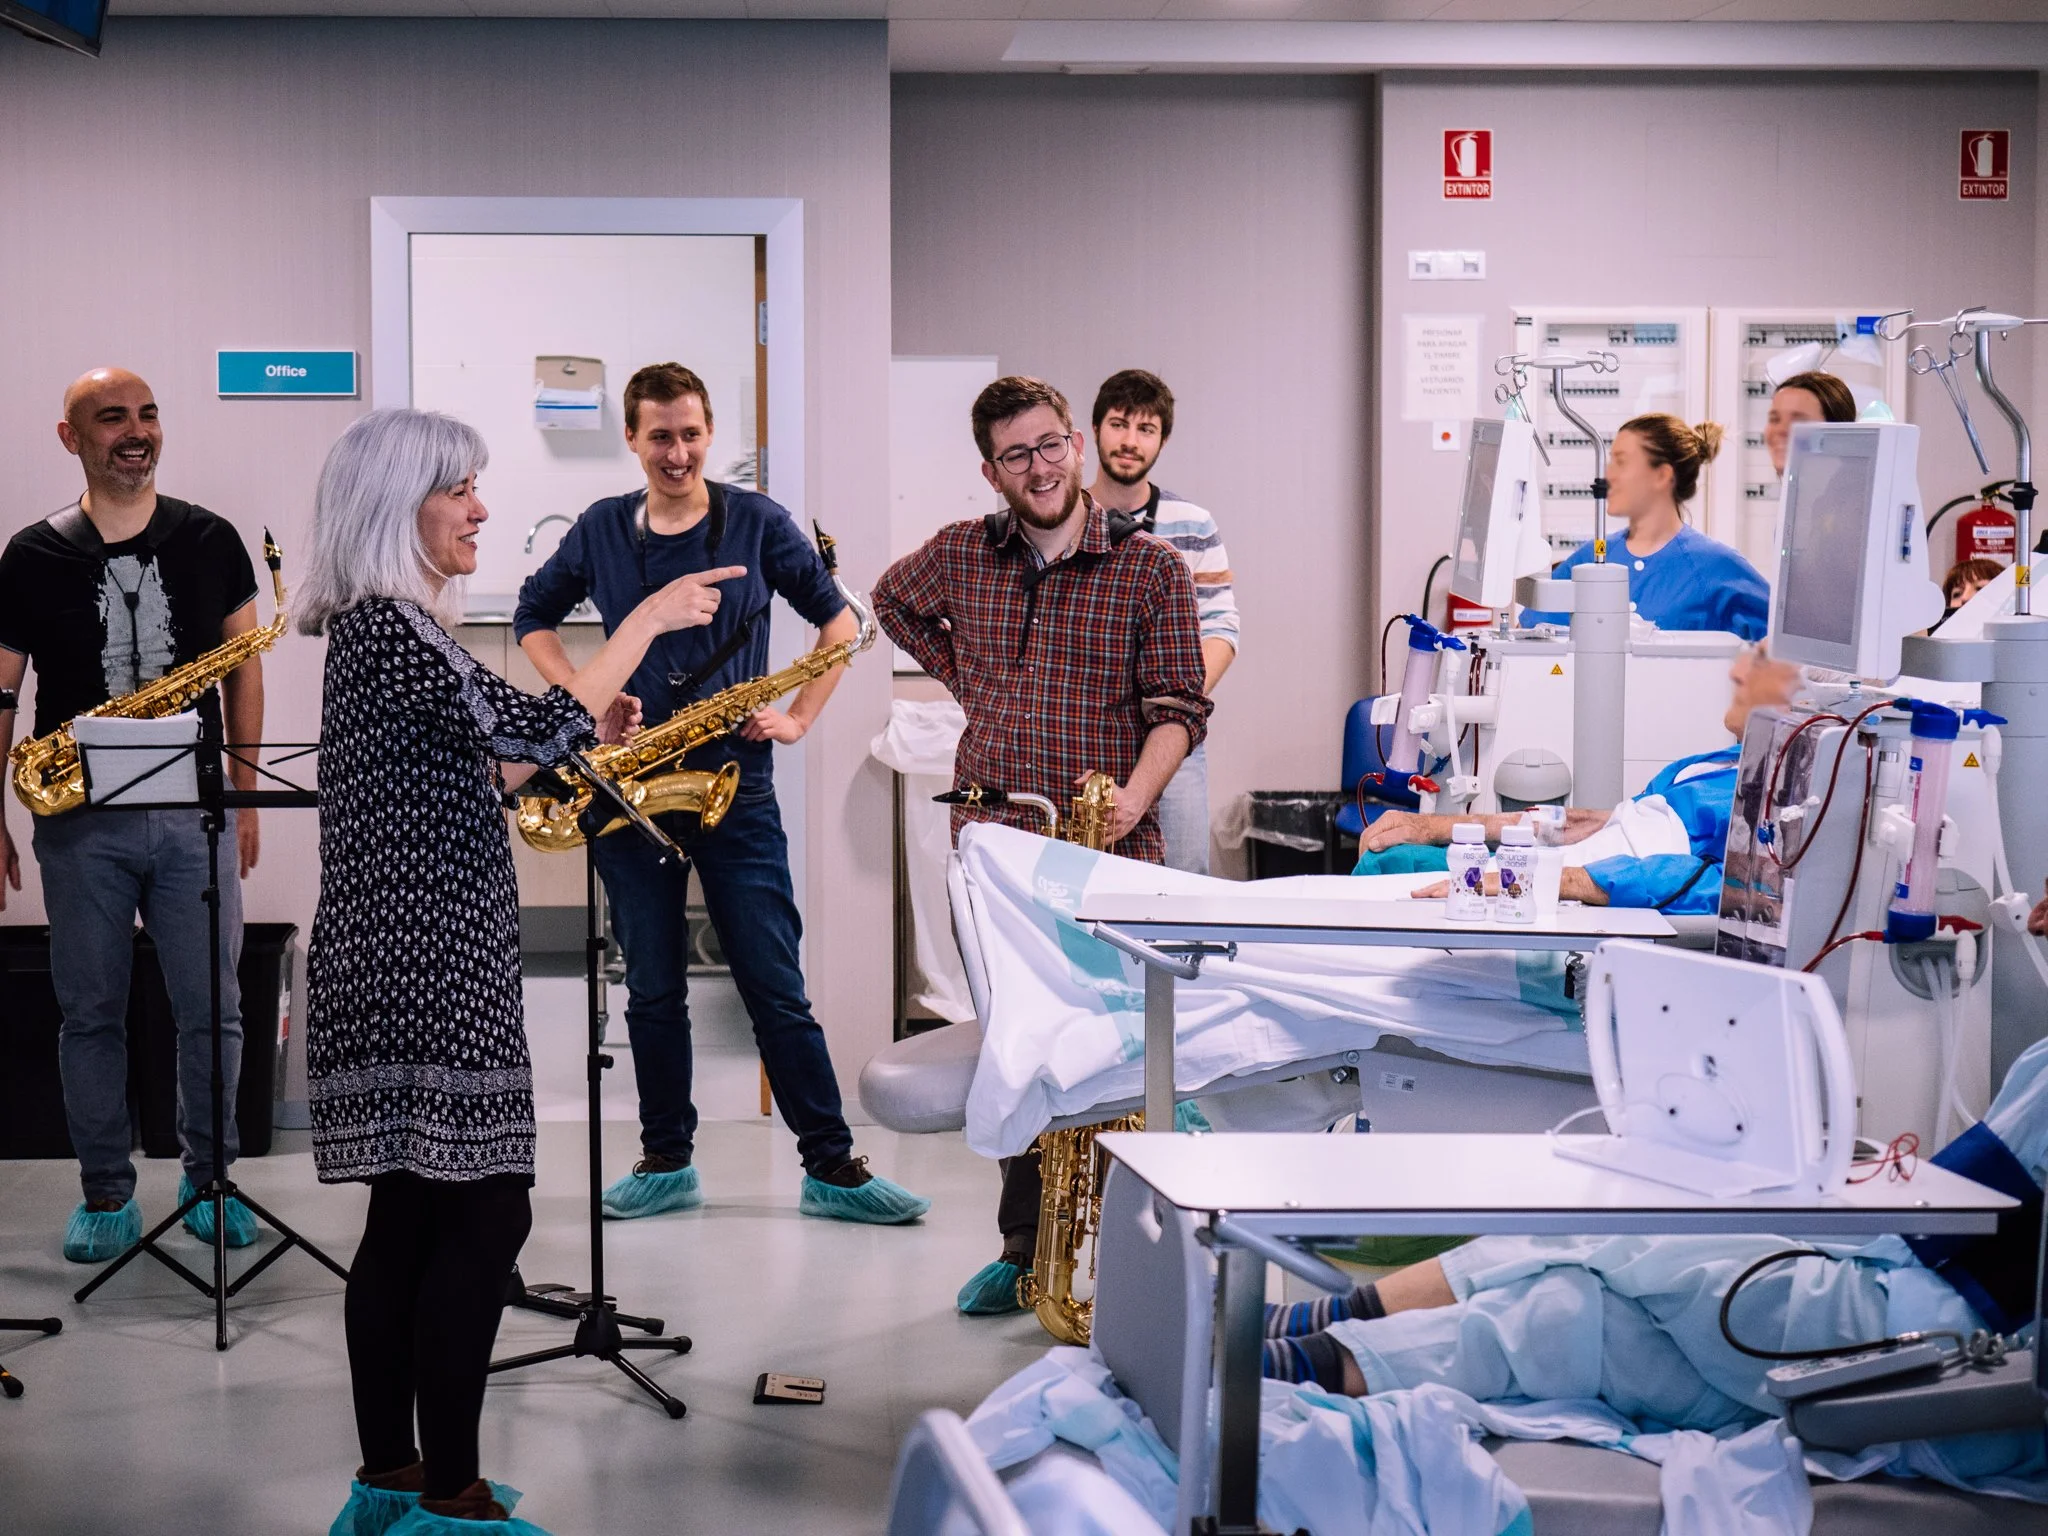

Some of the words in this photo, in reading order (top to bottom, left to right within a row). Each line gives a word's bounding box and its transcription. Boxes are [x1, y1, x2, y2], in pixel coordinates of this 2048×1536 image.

[1446, 182, 1490, 196] EXTINTOR
[1962, 183, 2006, 196] EXTINTOR
[265, 364, 308, 377] Office
